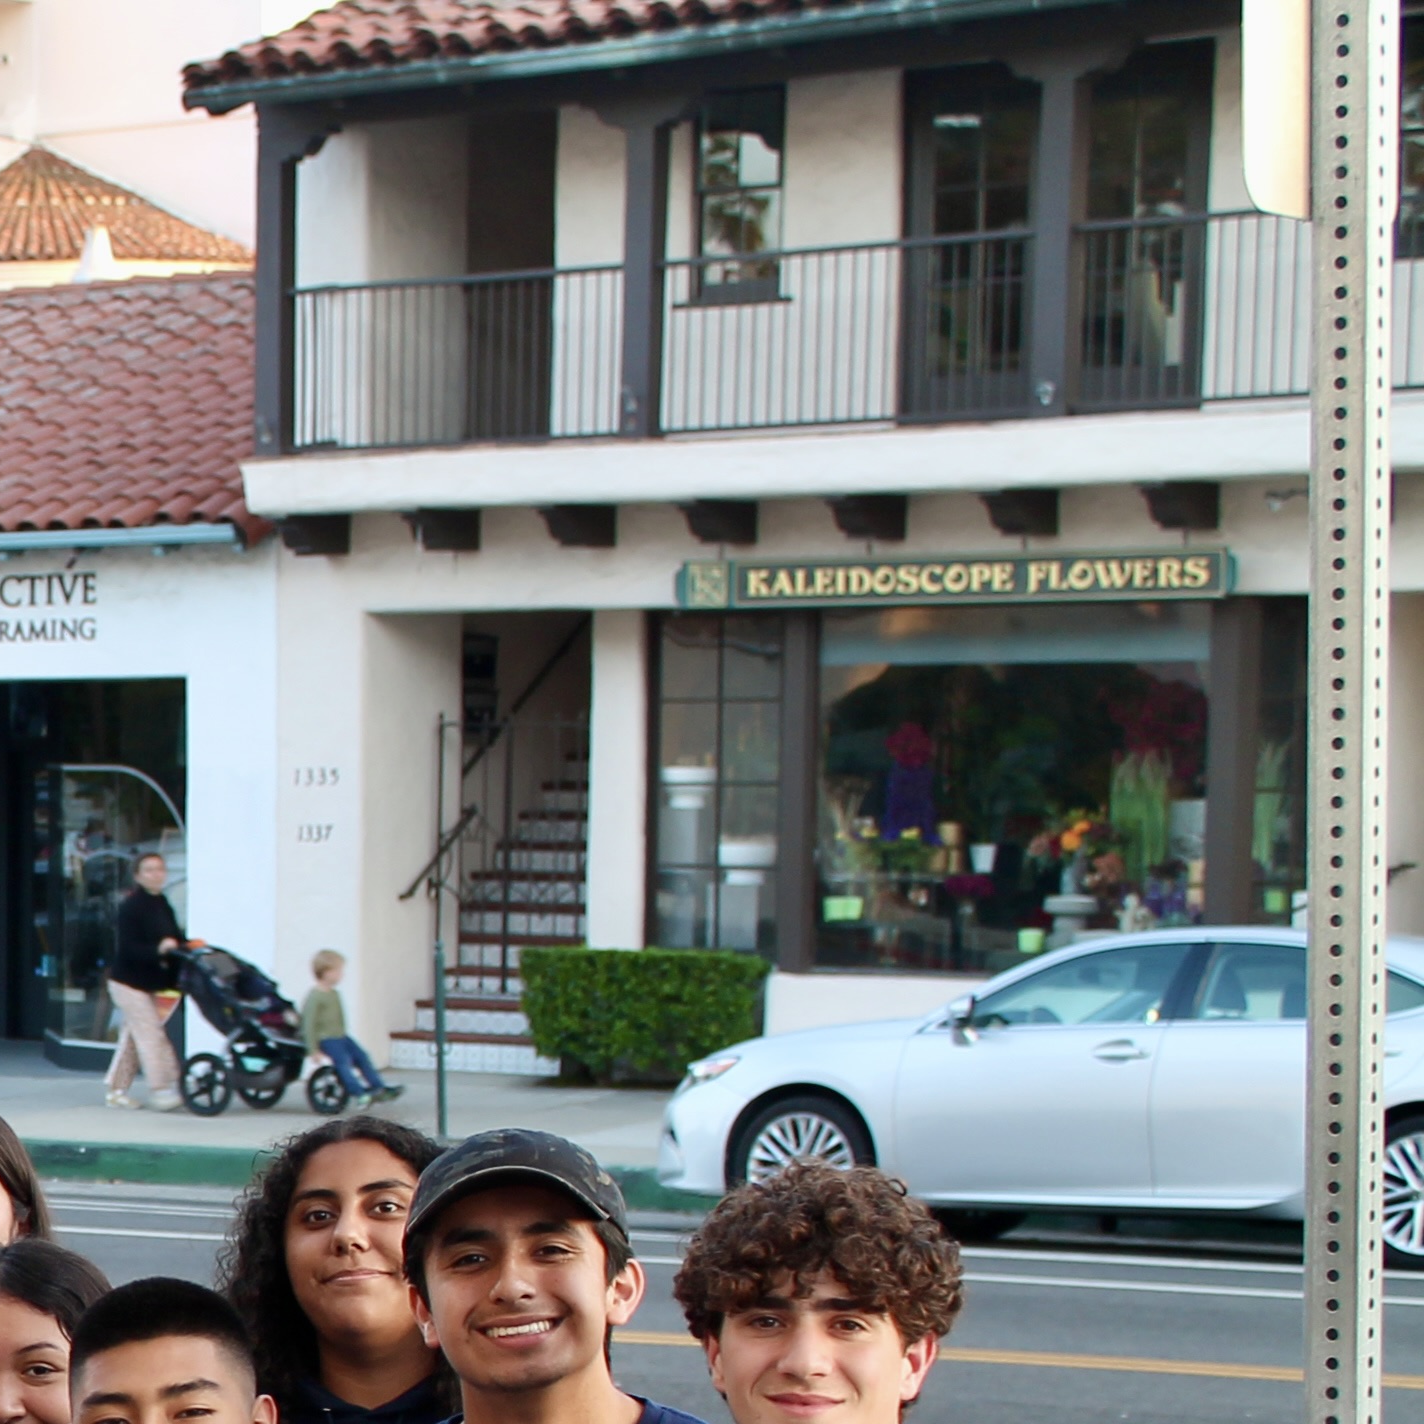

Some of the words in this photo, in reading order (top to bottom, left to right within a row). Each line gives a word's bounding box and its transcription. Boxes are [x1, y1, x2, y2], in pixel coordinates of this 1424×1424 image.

[747, 560, 1015, 598] KALEIDOSCOPE
[1026, 556, 1211, 595] FLOWERS
[294, 767, 340, 787] 1335
[298, 823, 333, 843] 1337
